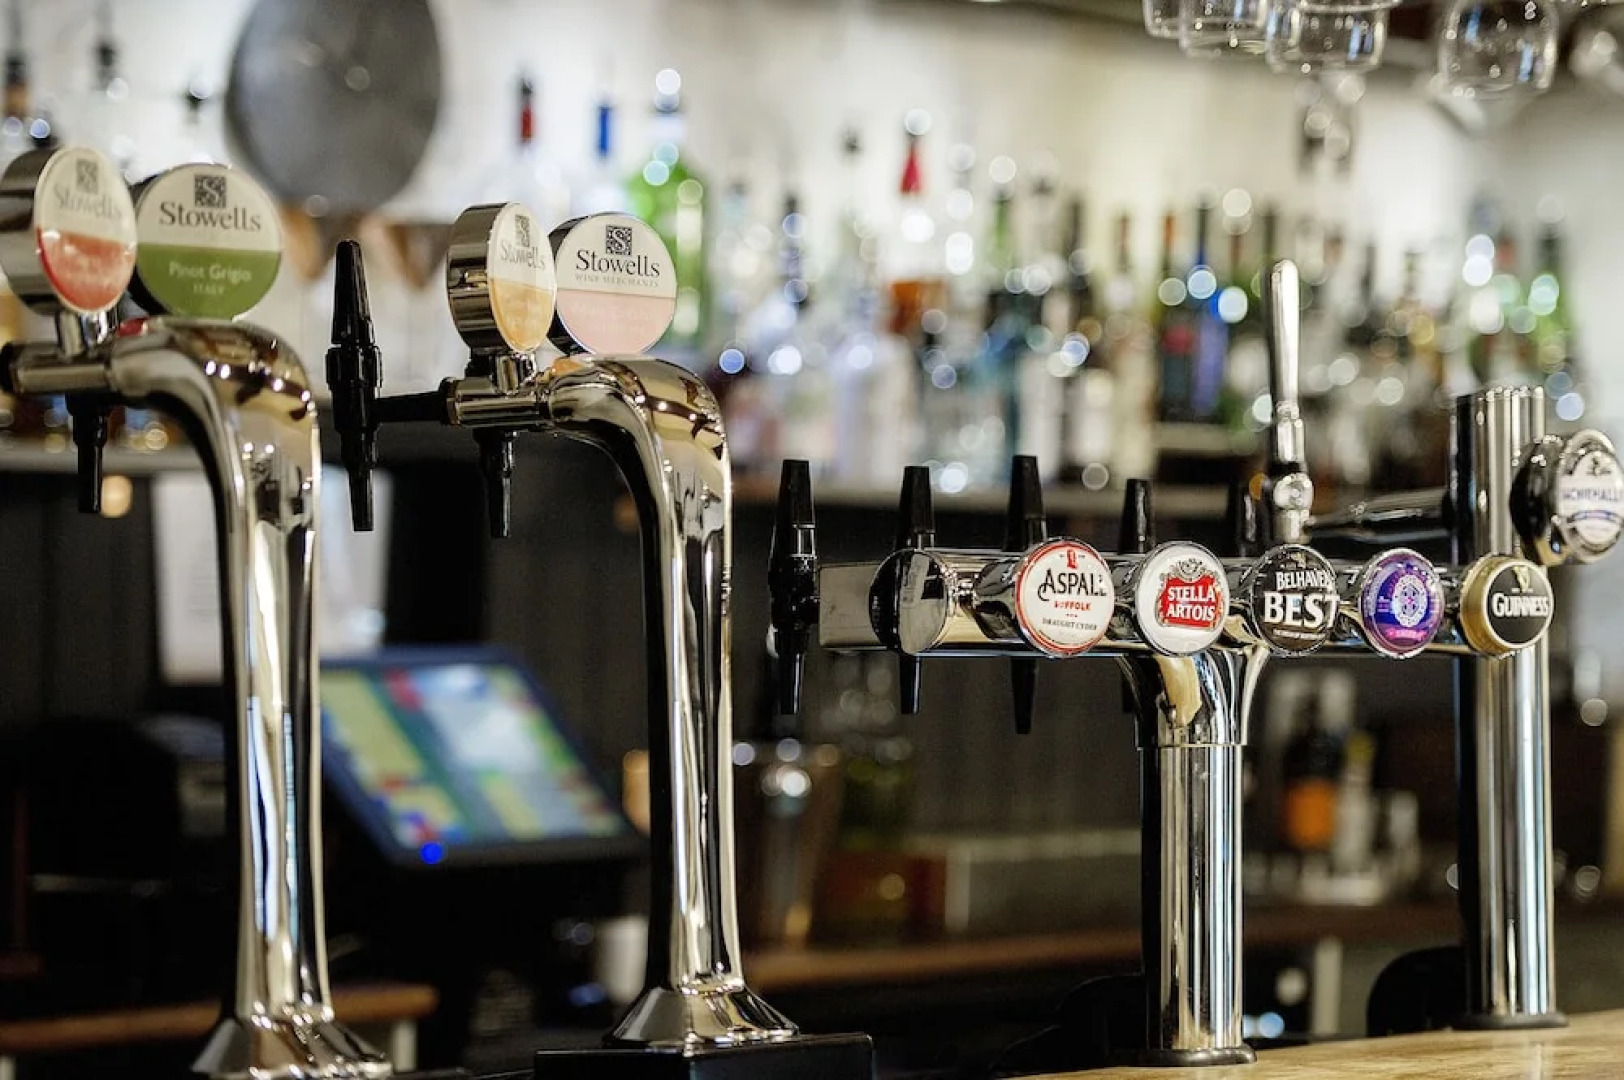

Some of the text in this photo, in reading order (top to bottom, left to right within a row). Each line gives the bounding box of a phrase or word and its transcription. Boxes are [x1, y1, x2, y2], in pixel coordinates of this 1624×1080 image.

[159, 201, 262, 231] Stowells
[501, 240, 546, 270] Stowells
[575, 249, 661, 278] Stowells
[209, 264, 253, 285] Grigio
[1037, 567, 1107, 602] ASPALL
[1167, 585, 1216, 602] STELLA
[1167, 603, 1216, 621] ARTOIS
[1263, 590, 1340, 628] BEST
[1492, 592, 1549, 618] GUINNESS
